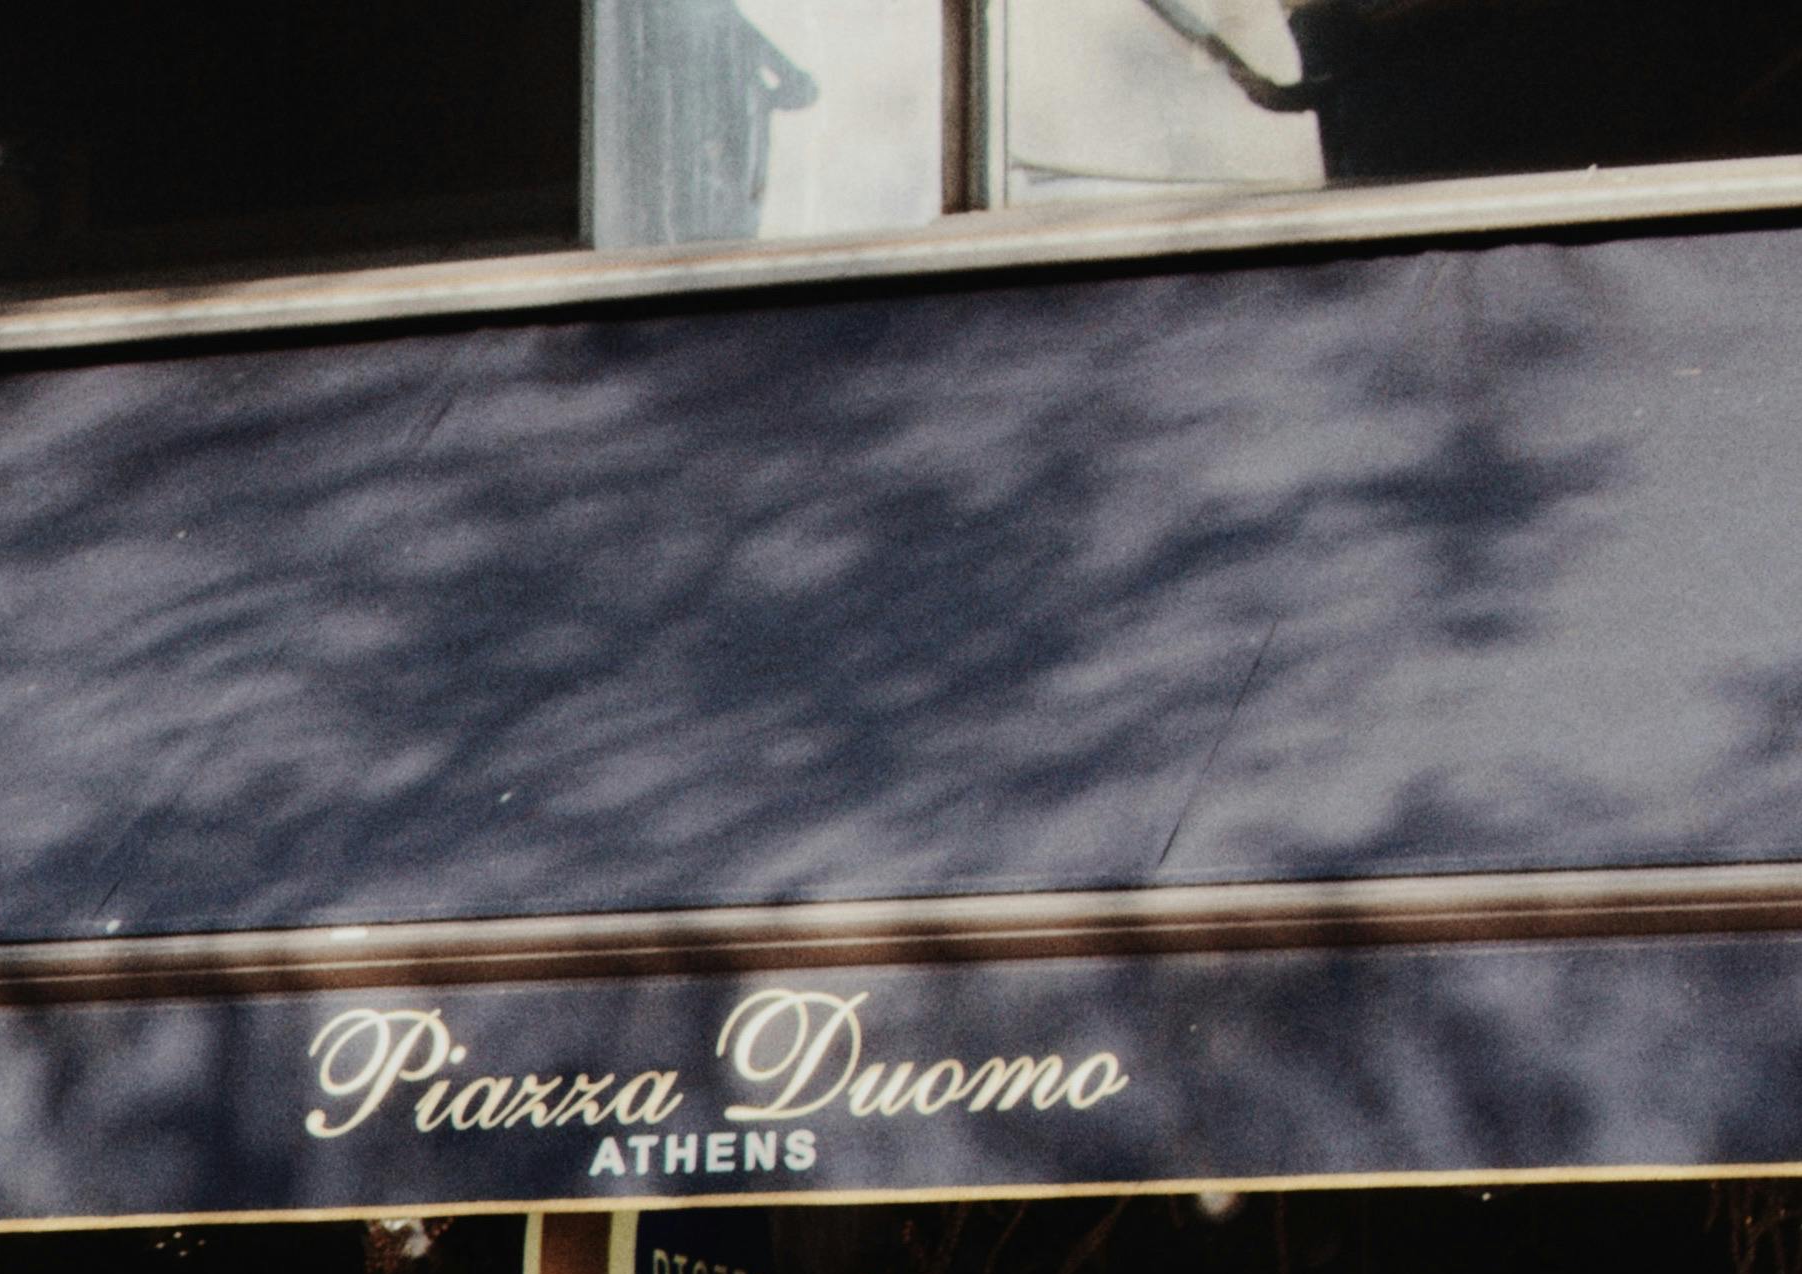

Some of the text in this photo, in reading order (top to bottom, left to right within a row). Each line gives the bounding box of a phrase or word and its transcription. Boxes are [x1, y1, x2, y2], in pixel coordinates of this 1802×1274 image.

[304, 988, 1131, 1140] Piazza Duomo
[588, 1128, 818, 1178] ATHENS
